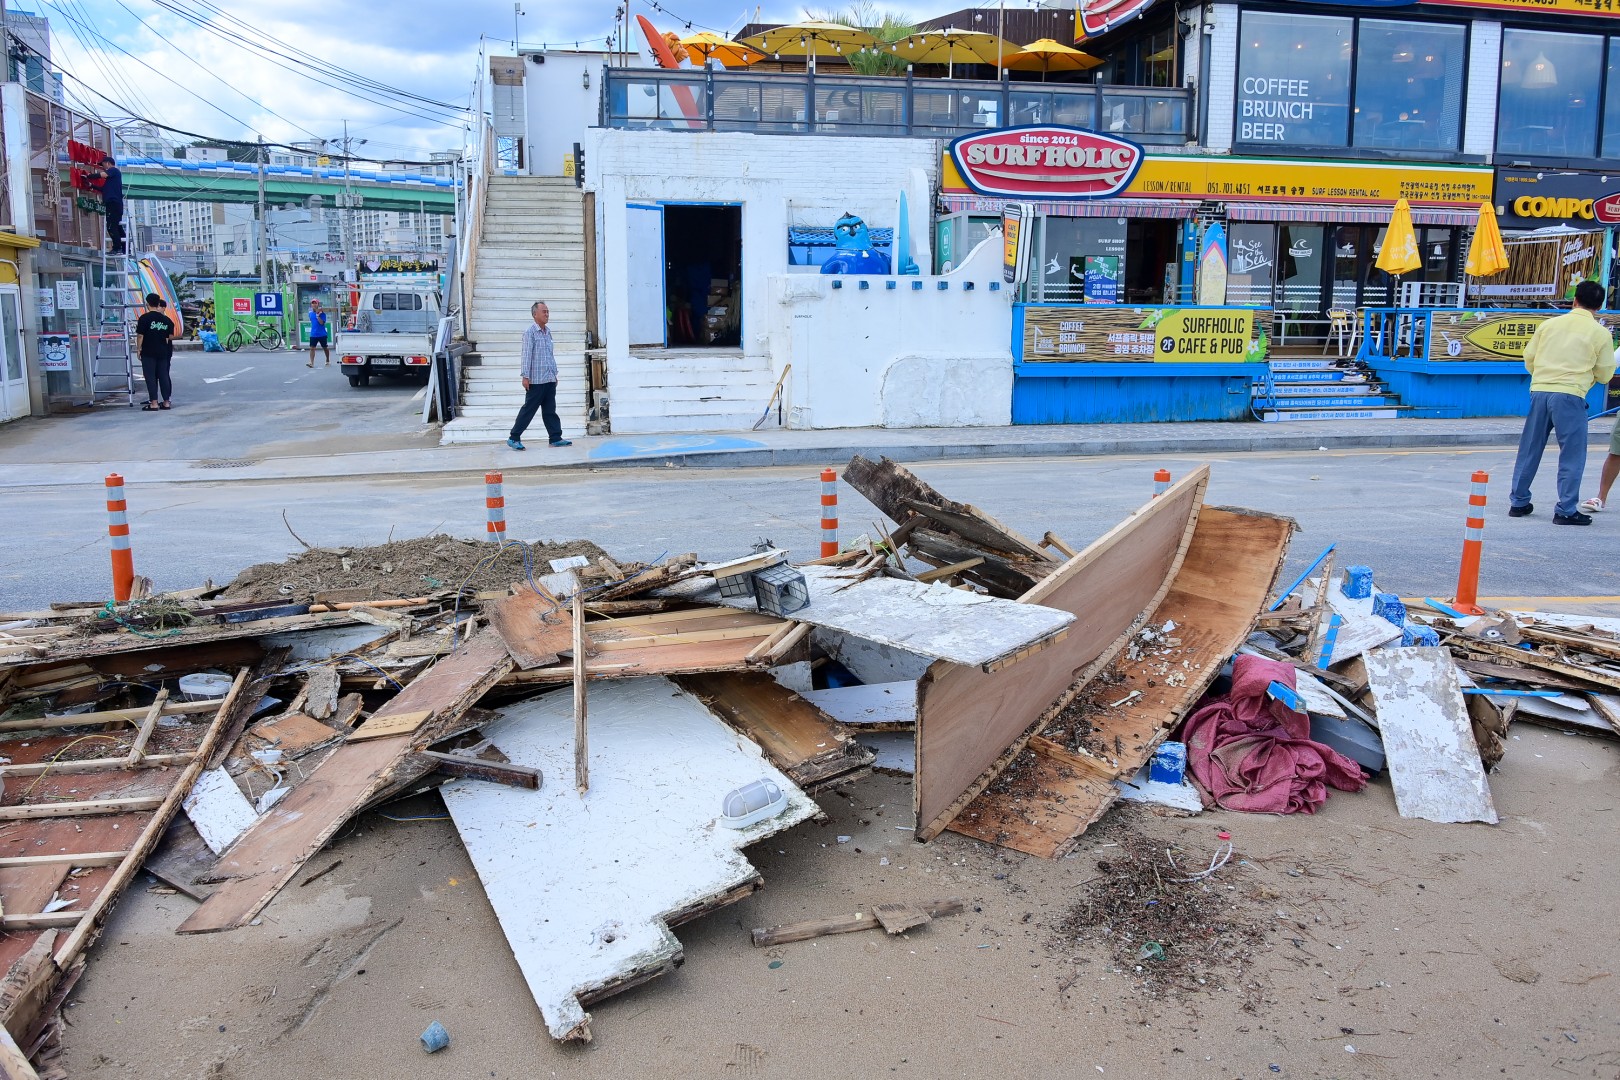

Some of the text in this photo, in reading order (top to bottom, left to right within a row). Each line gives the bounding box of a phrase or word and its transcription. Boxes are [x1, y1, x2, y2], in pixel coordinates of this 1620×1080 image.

[1243, 77, 1309, 97] COFFEE
[1242, 100, 1313, 120] BRUNCH
[1241, 122, 1285, 141] BEER
[1019, 133, 1078, 146] since 2014
[1207, 182, 1251, 195] 051.701.4851
[1256, 185, 1305, 196] 서프홀릭 송정
[1312, 187, 1380, 198] SURF LESSON RENTAL ACC
[1248, 240, 1262, 249] See
[1254, 248, 1264, 257] the
[1245, 251, 1268, 268] Sea
[264, 296, 272, 306] P
[1059, 321, 1084, 332] COFFEE
[1182, 317, 1245, 334] SURFHOLIC
[1496, 323, 1537, 337] 서프홀릭
[1059, 332, 1077, 343] BEER
[1107, 332, 1138, 344] 서프홀릭
[1058, 343, 1086, 354] BRUNCH
[1114, 344, 1154, 354] 공영 주차장
[1162, 338, 1173, 351] 2F
[1178, 337, 1244, 354] CAFE & PUB
[1450, 342, 1459, 354] 1F
